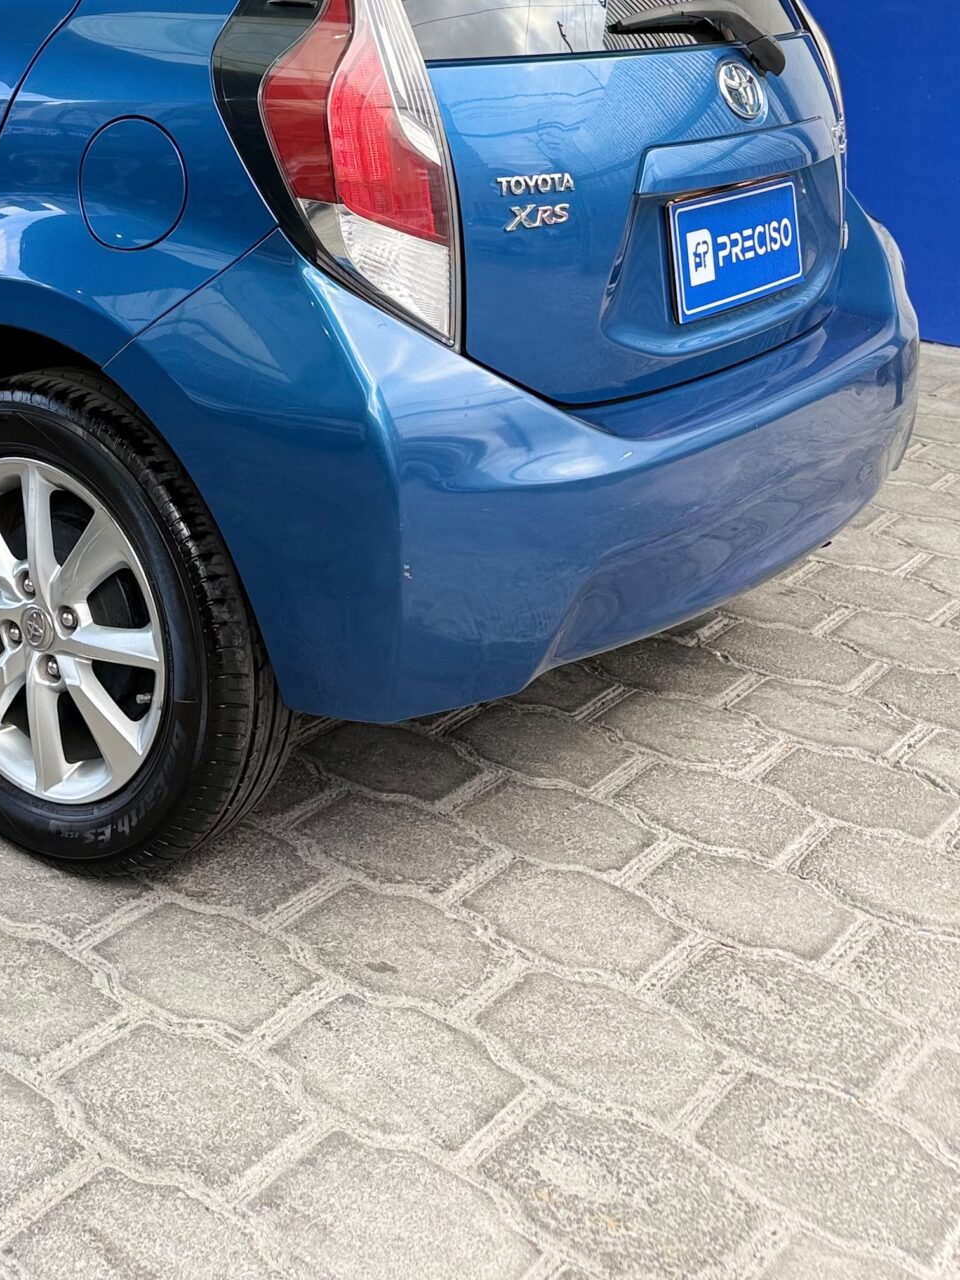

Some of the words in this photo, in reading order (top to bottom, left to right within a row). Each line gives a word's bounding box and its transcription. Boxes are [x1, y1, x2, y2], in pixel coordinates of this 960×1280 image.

[496, 172, 576, 197] TOYOTA
[503, 203, 570, 232] XRS
[716, 217, 793, 267] PRECISO
